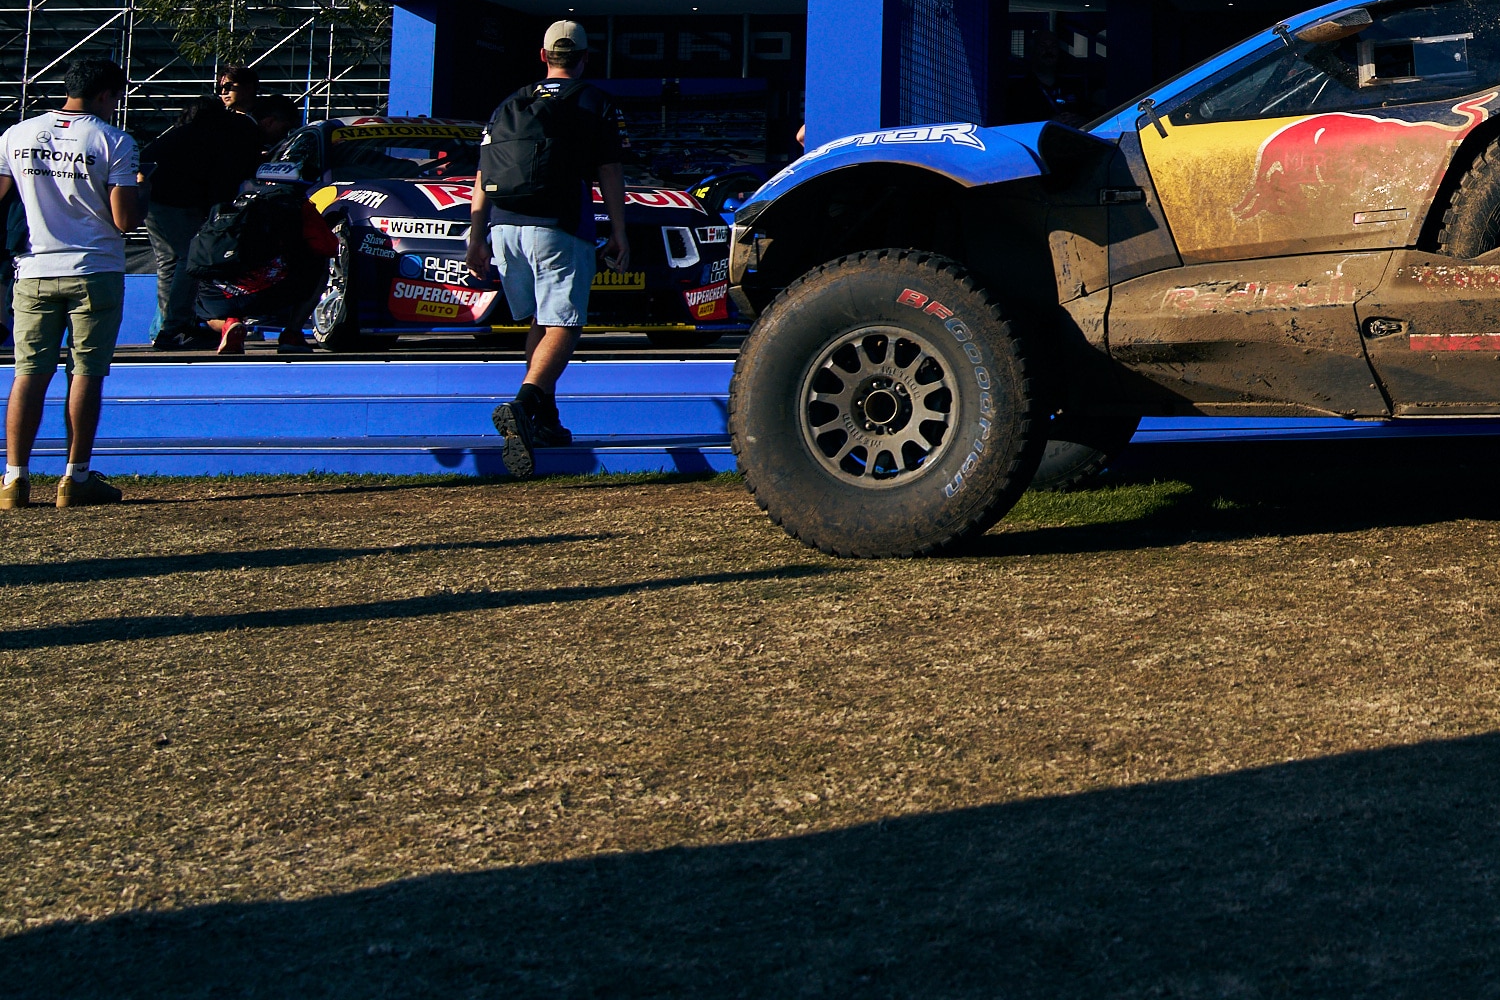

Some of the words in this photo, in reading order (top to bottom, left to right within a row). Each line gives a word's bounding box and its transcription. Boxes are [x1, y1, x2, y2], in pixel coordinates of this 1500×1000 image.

[336, 127, 458, 139] NATIONAL
[14, 148, 97, 165] PETRONAS
[22, 168, 90, 180] CROWDSTRIKE
[391, 221, 446, 235] WÜRTH
[363, 233, 386, 246] Shaw
[358, 243, 396, 259] Partners
[424, 256, 469, 274] QUAD
[424, 269, 470, 286] LOCK
[592, 268, 646, 287] ntury
[393, 282, 492, 307] SUPERCHEAP
[420, 305, 454, 315] AUTO
